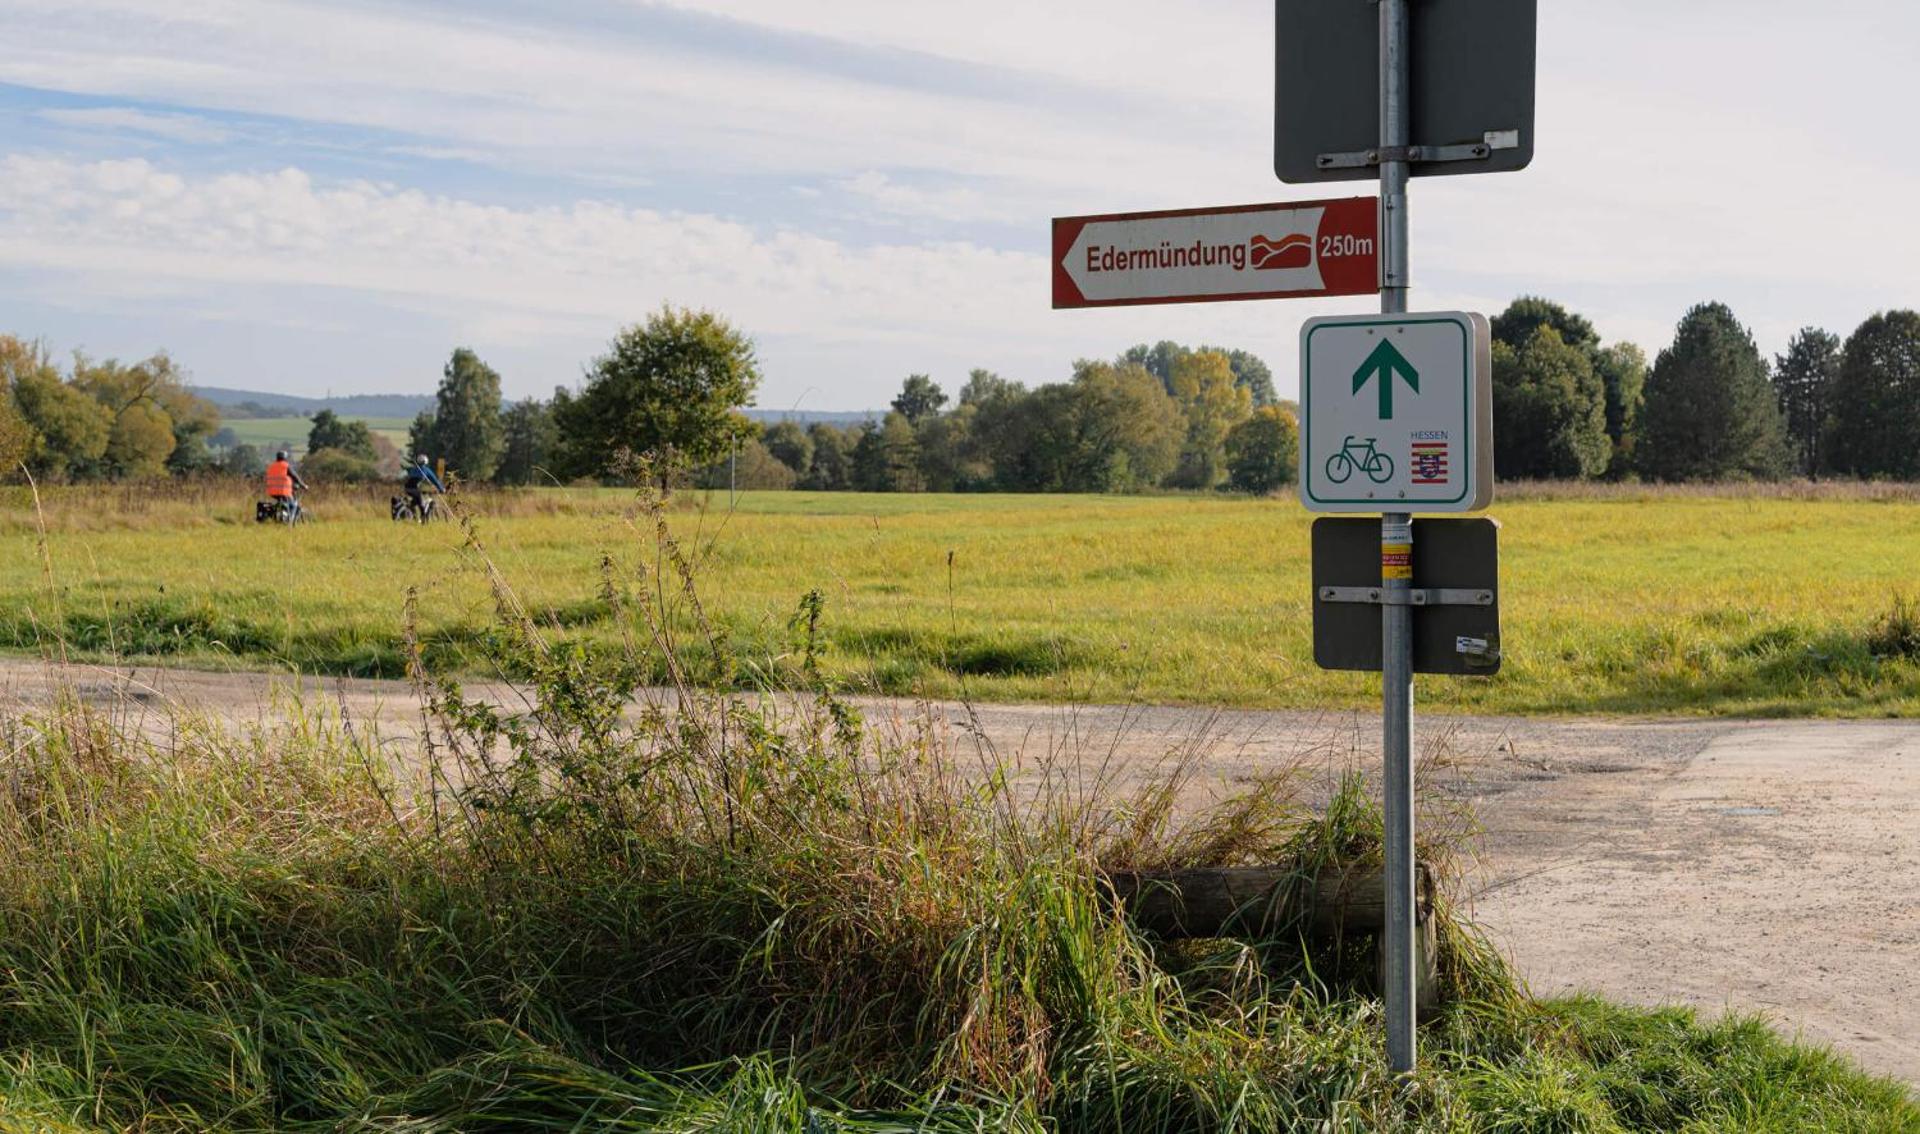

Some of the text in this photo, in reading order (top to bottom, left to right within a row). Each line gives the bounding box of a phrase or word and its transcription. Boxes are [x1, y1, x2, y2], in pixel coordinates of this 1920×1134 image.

[1086, 234, 1374, 273] Edermündung 250m
[1410, 430, 1449, 440] HESSEN
